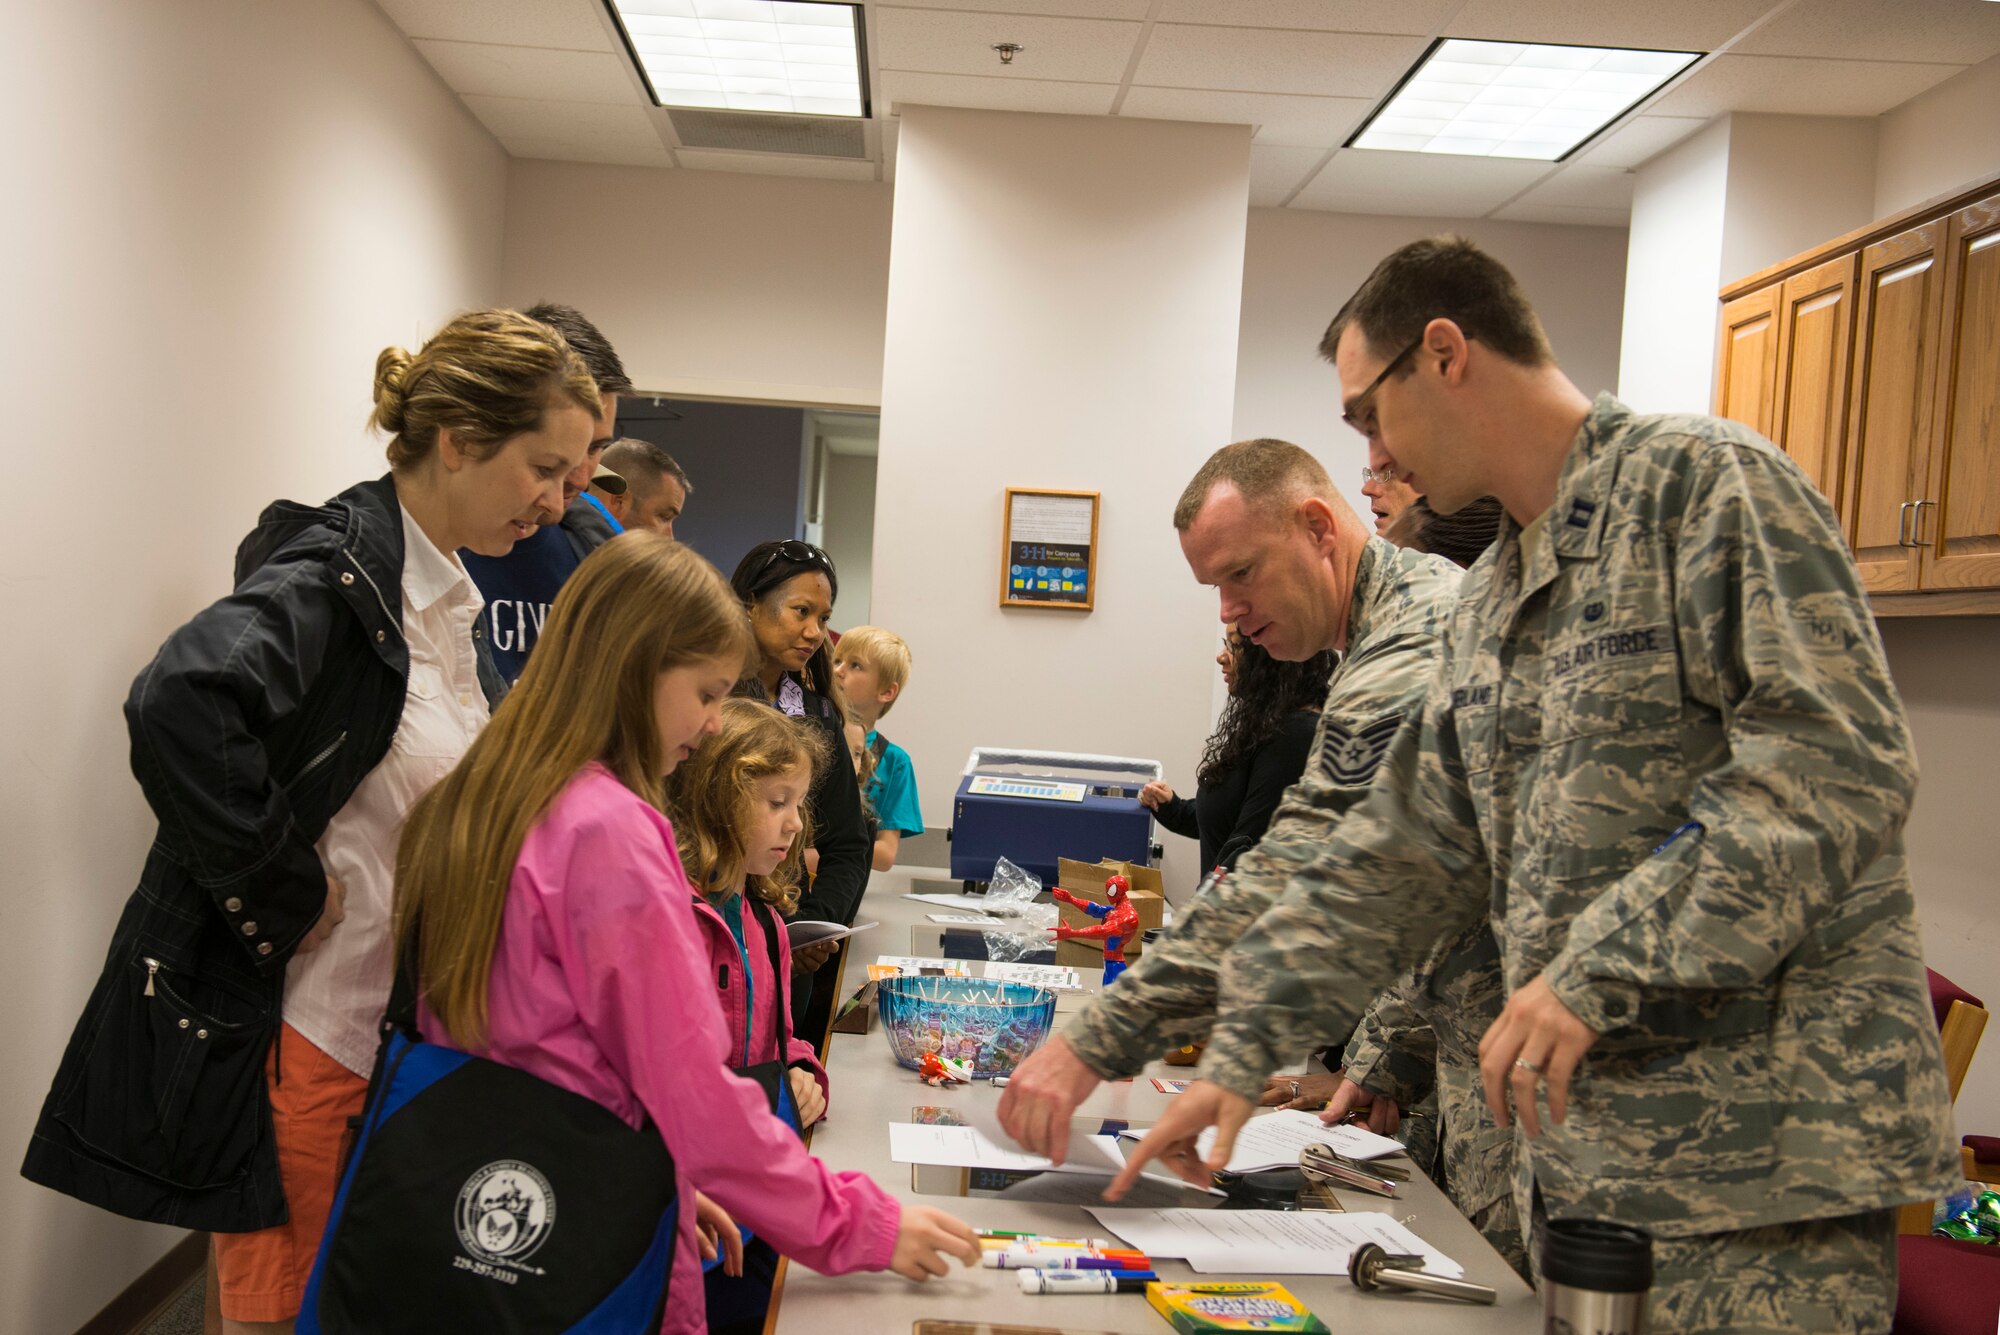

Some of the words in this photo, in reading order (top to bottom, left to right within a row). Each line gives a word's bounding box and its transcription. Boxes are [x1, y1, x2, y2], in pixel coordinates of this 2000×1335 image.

[1020, 545, 1046, 561] 3-1-1
[491, 599, 554, 652] GIV
[1575, 641, 1595, 667] AIR
[1598, 629, 1659, 659] FORCE
[1171, 1283, 1266, 1292] Crayola
